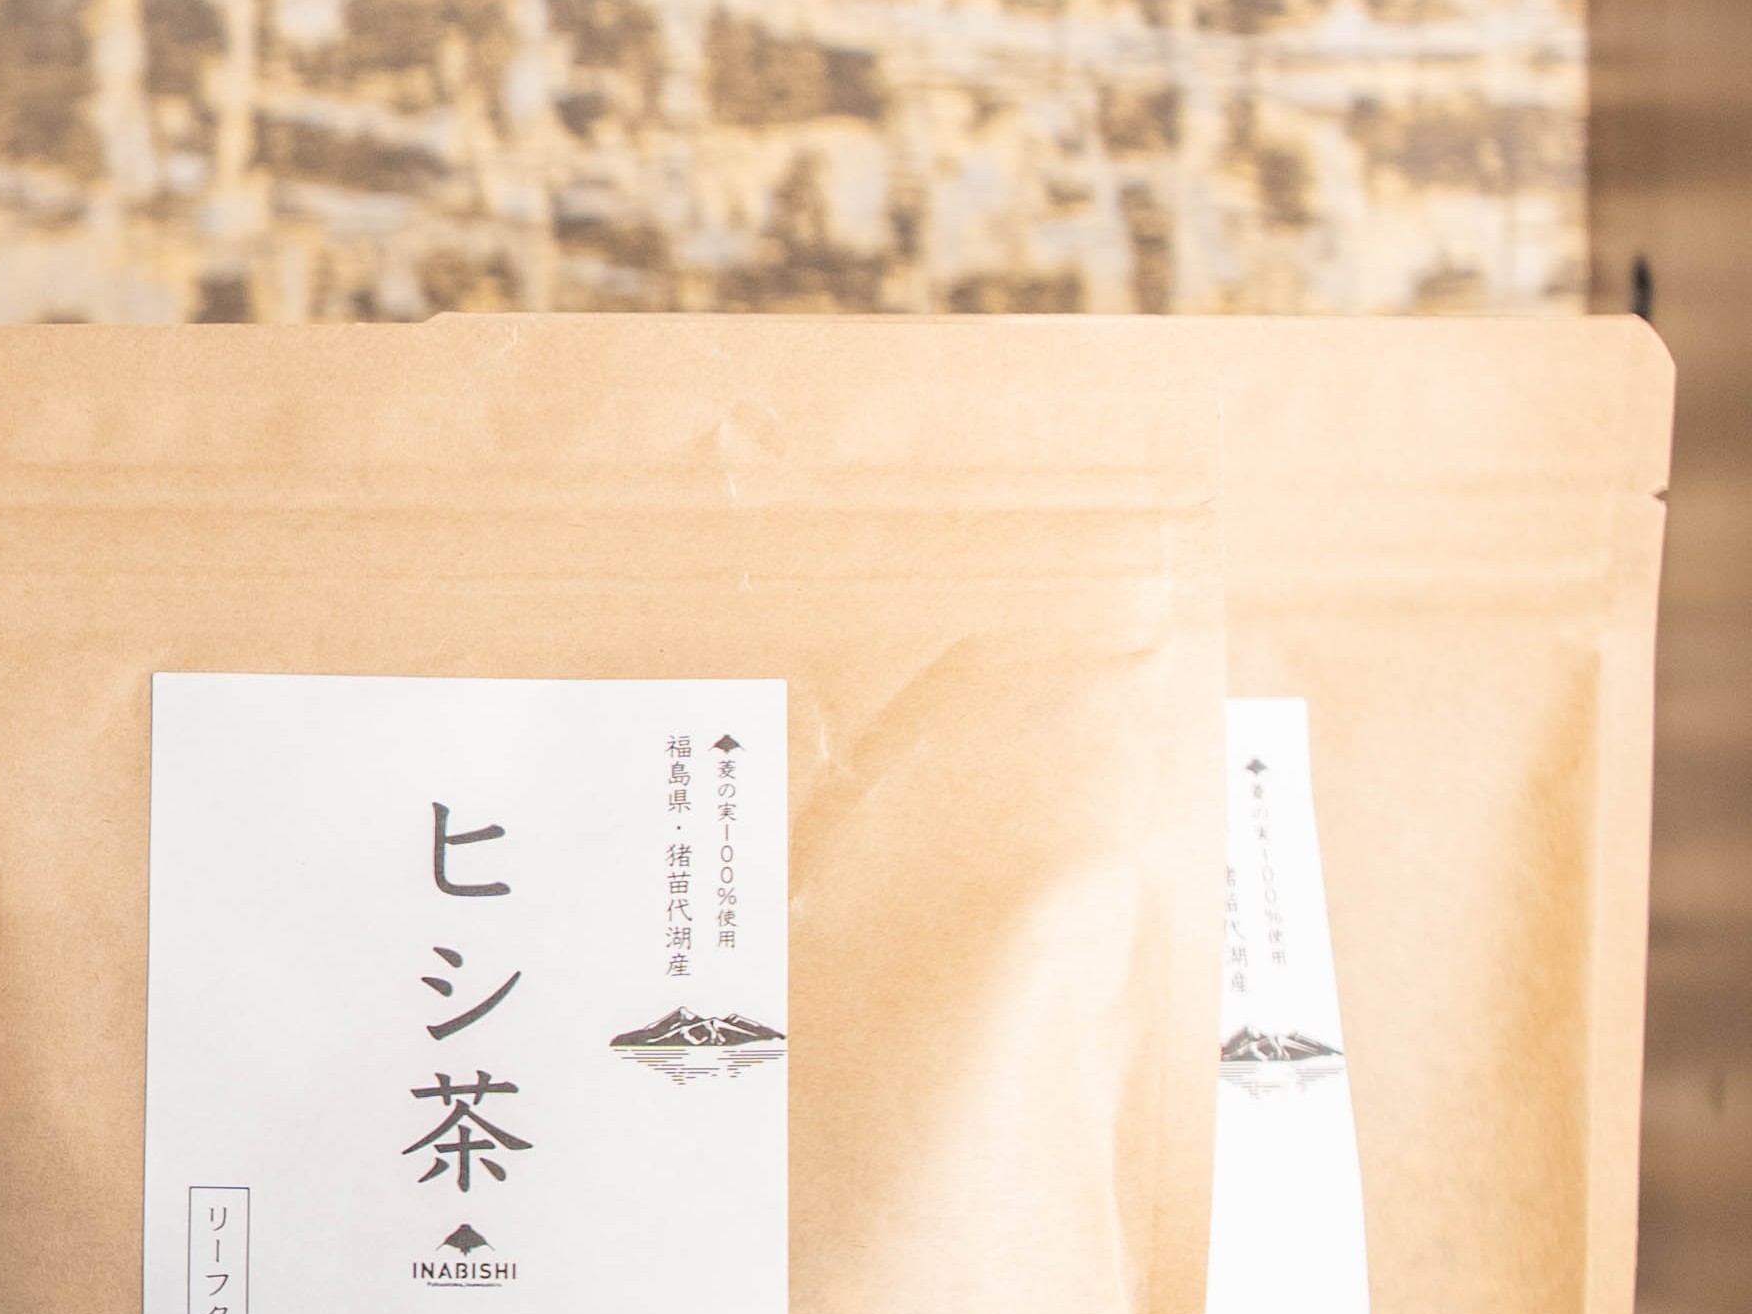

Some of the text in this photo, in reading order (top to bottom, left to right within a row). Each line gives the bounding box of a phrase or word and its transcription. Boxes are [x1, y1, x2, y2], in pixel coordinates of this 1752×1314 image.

[665, 734, 693, 977] 福島県・猪苗代湖産
[717, 760, 737, 949] 菱の実100%使用
[401, 801, 534, 1194] ヒシ茶
[412, 1262, 516, 1280] INABISHI
